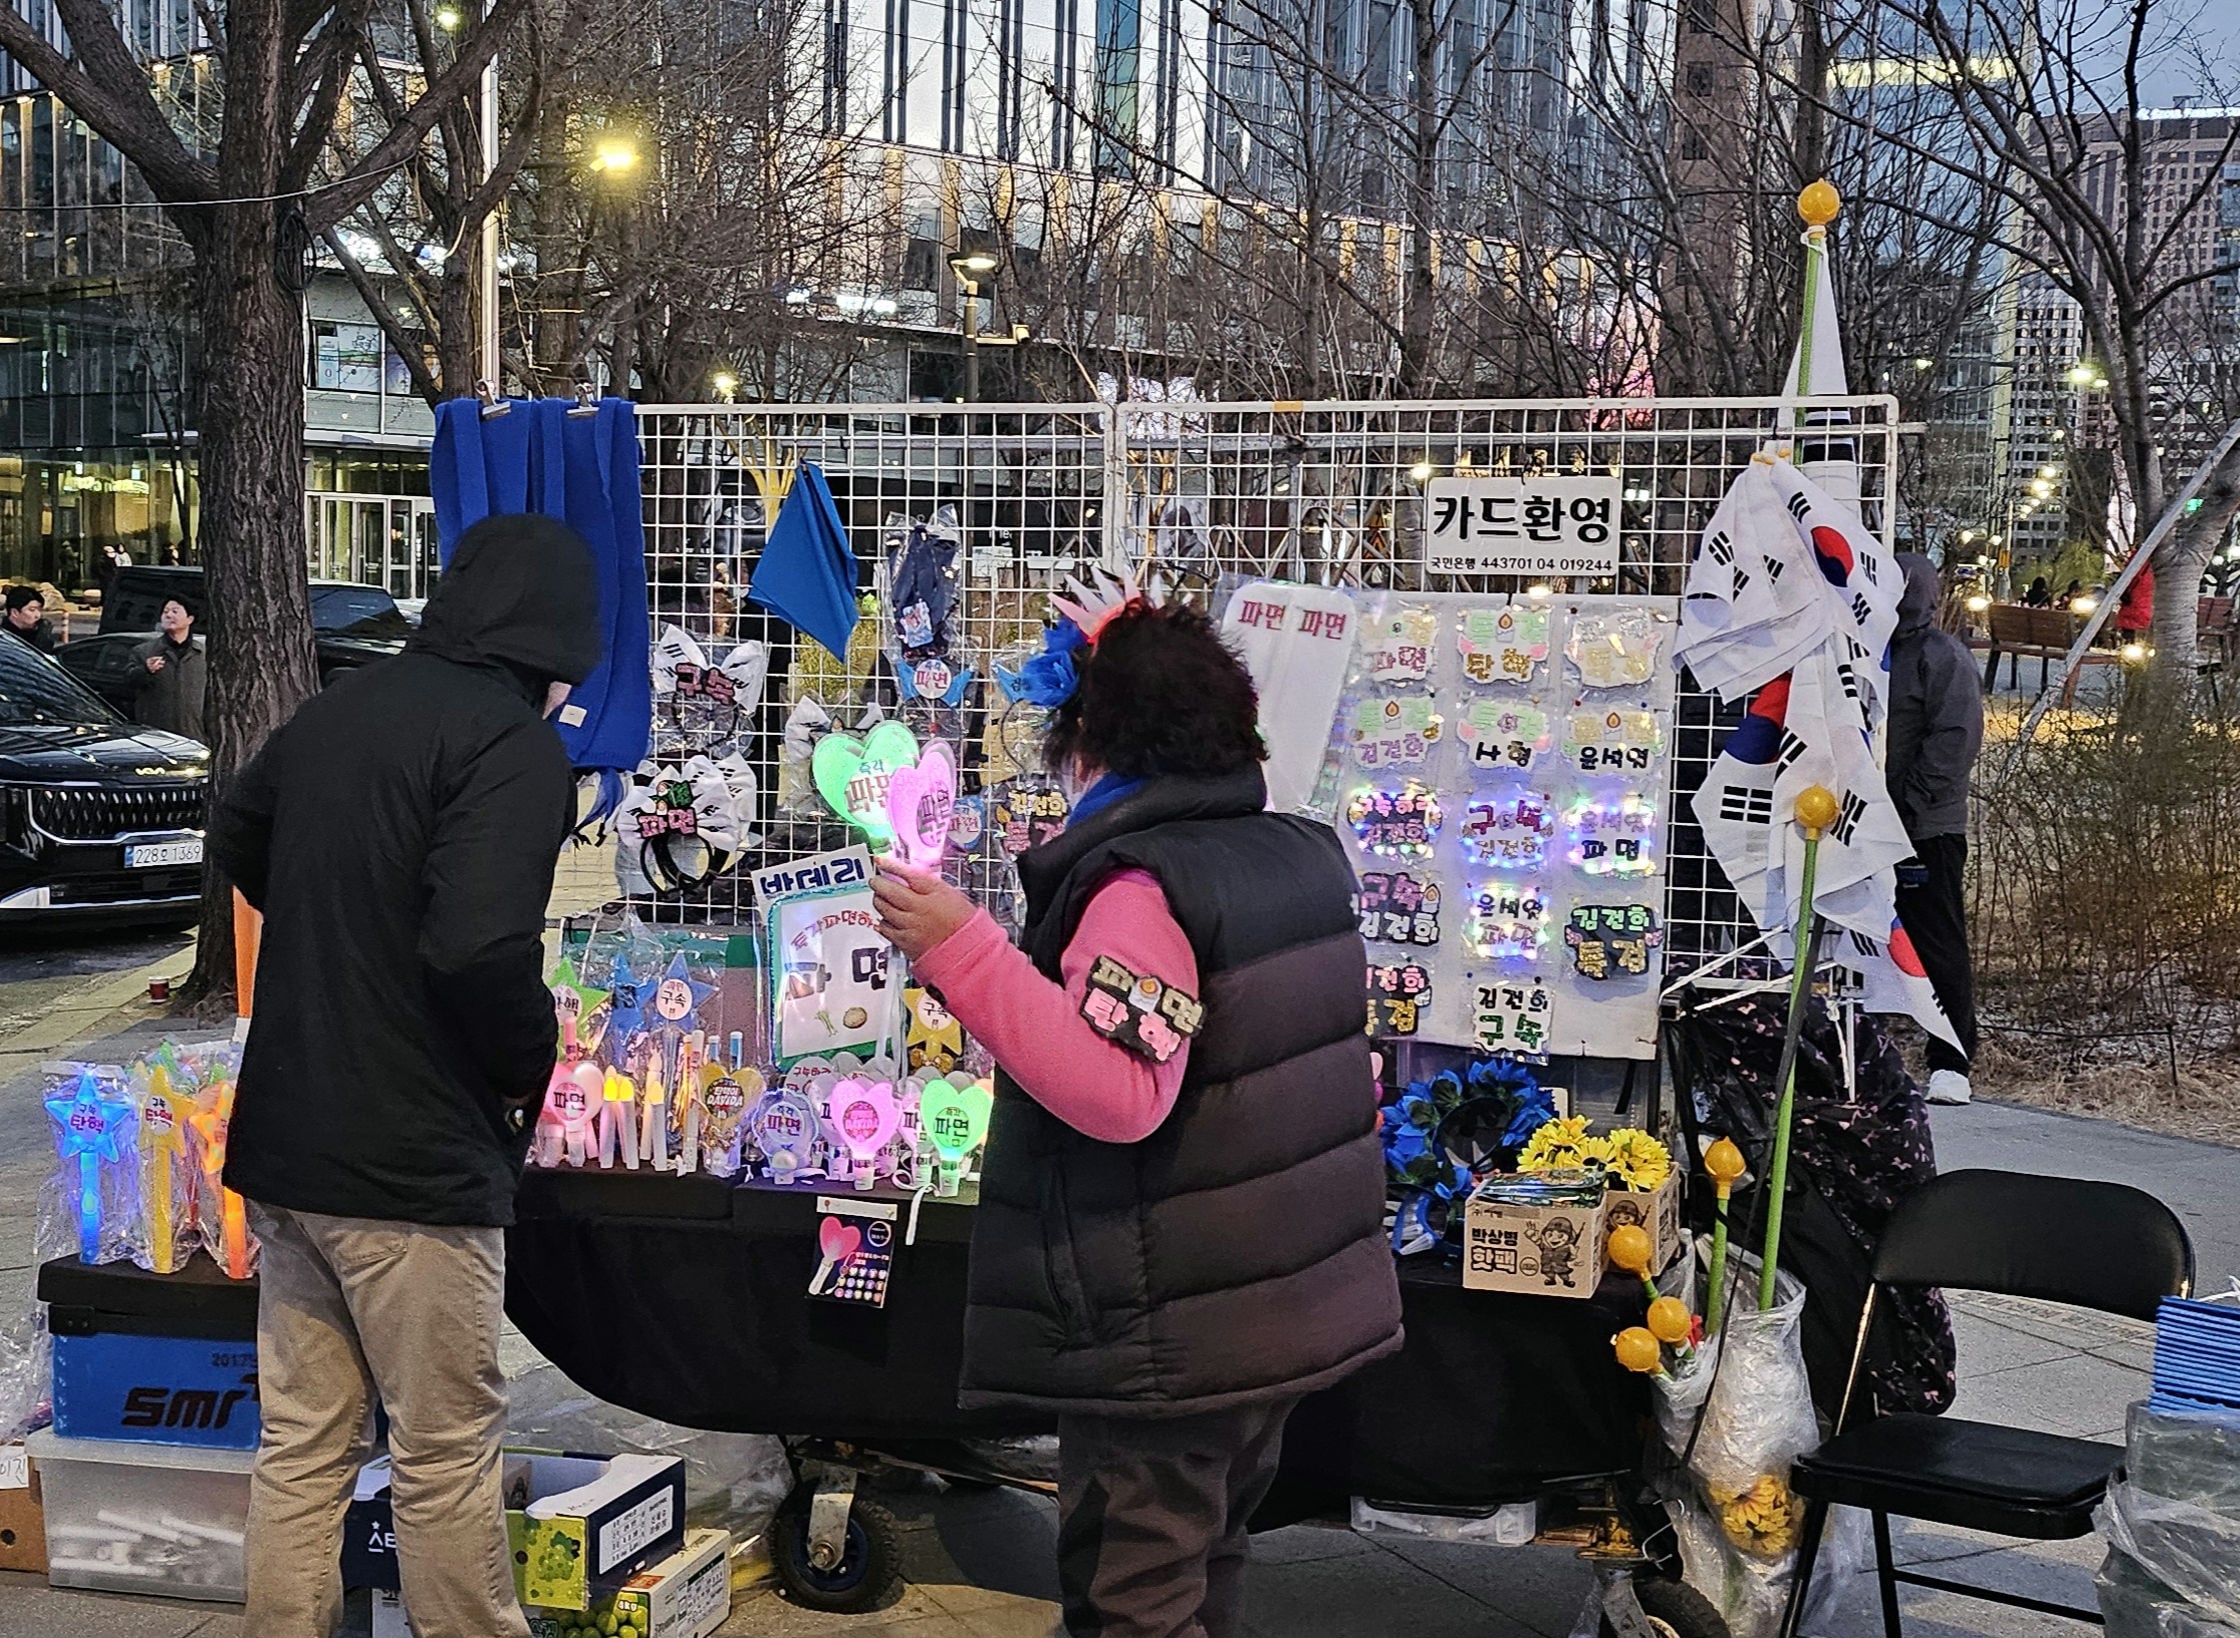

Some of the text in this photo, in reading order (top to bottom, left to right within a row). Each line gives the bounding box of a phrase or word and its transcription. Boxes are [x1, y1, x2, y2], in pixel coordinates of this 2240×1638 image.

[1434, 496, 1610, 543] 카드환영
[1432, 557, 1612, 571] 국민은행 443701 04 019244
[1238, 600, 1286, 631] 파면
[1298, 609, 1346, 640] 파면
[1468, 648, 1530, 680] 탄핵
[677, 664, 735, 705] 구속
[915, 670, 948, 690] 파면
[1359, 733, 1425, 763] 김건희
[1579, 746, 1649, 770] 윤석열
[638, 808, 695, 837] 파면
[1581, 838, 1640, 861] 파면
[760, 857, 865, 895] 바데리
[1358, 910, 1438, 942] 김건희
[1573, 906, 1649, 931] 김건희
[660, 990, 688, 1008] 구속
[1478, 986, 1548, 1012] 김건희
[1084, 986, 1182, 1062] 탄핵
[1364, 998, 1415, 1036] 검
[1479, 1013, 1544, 1050] 구속
[553, 1091, 586, 1112] 파면
[70, 1113, 105, 1134] 탄핵
[767, 1114, 800, 1137] 파면
[935, 1117, 969, 1138] 파면
[1471, 1227, 1518, 1247] 박상병
[1471, 1245, 1518, 1275] 핫팩
